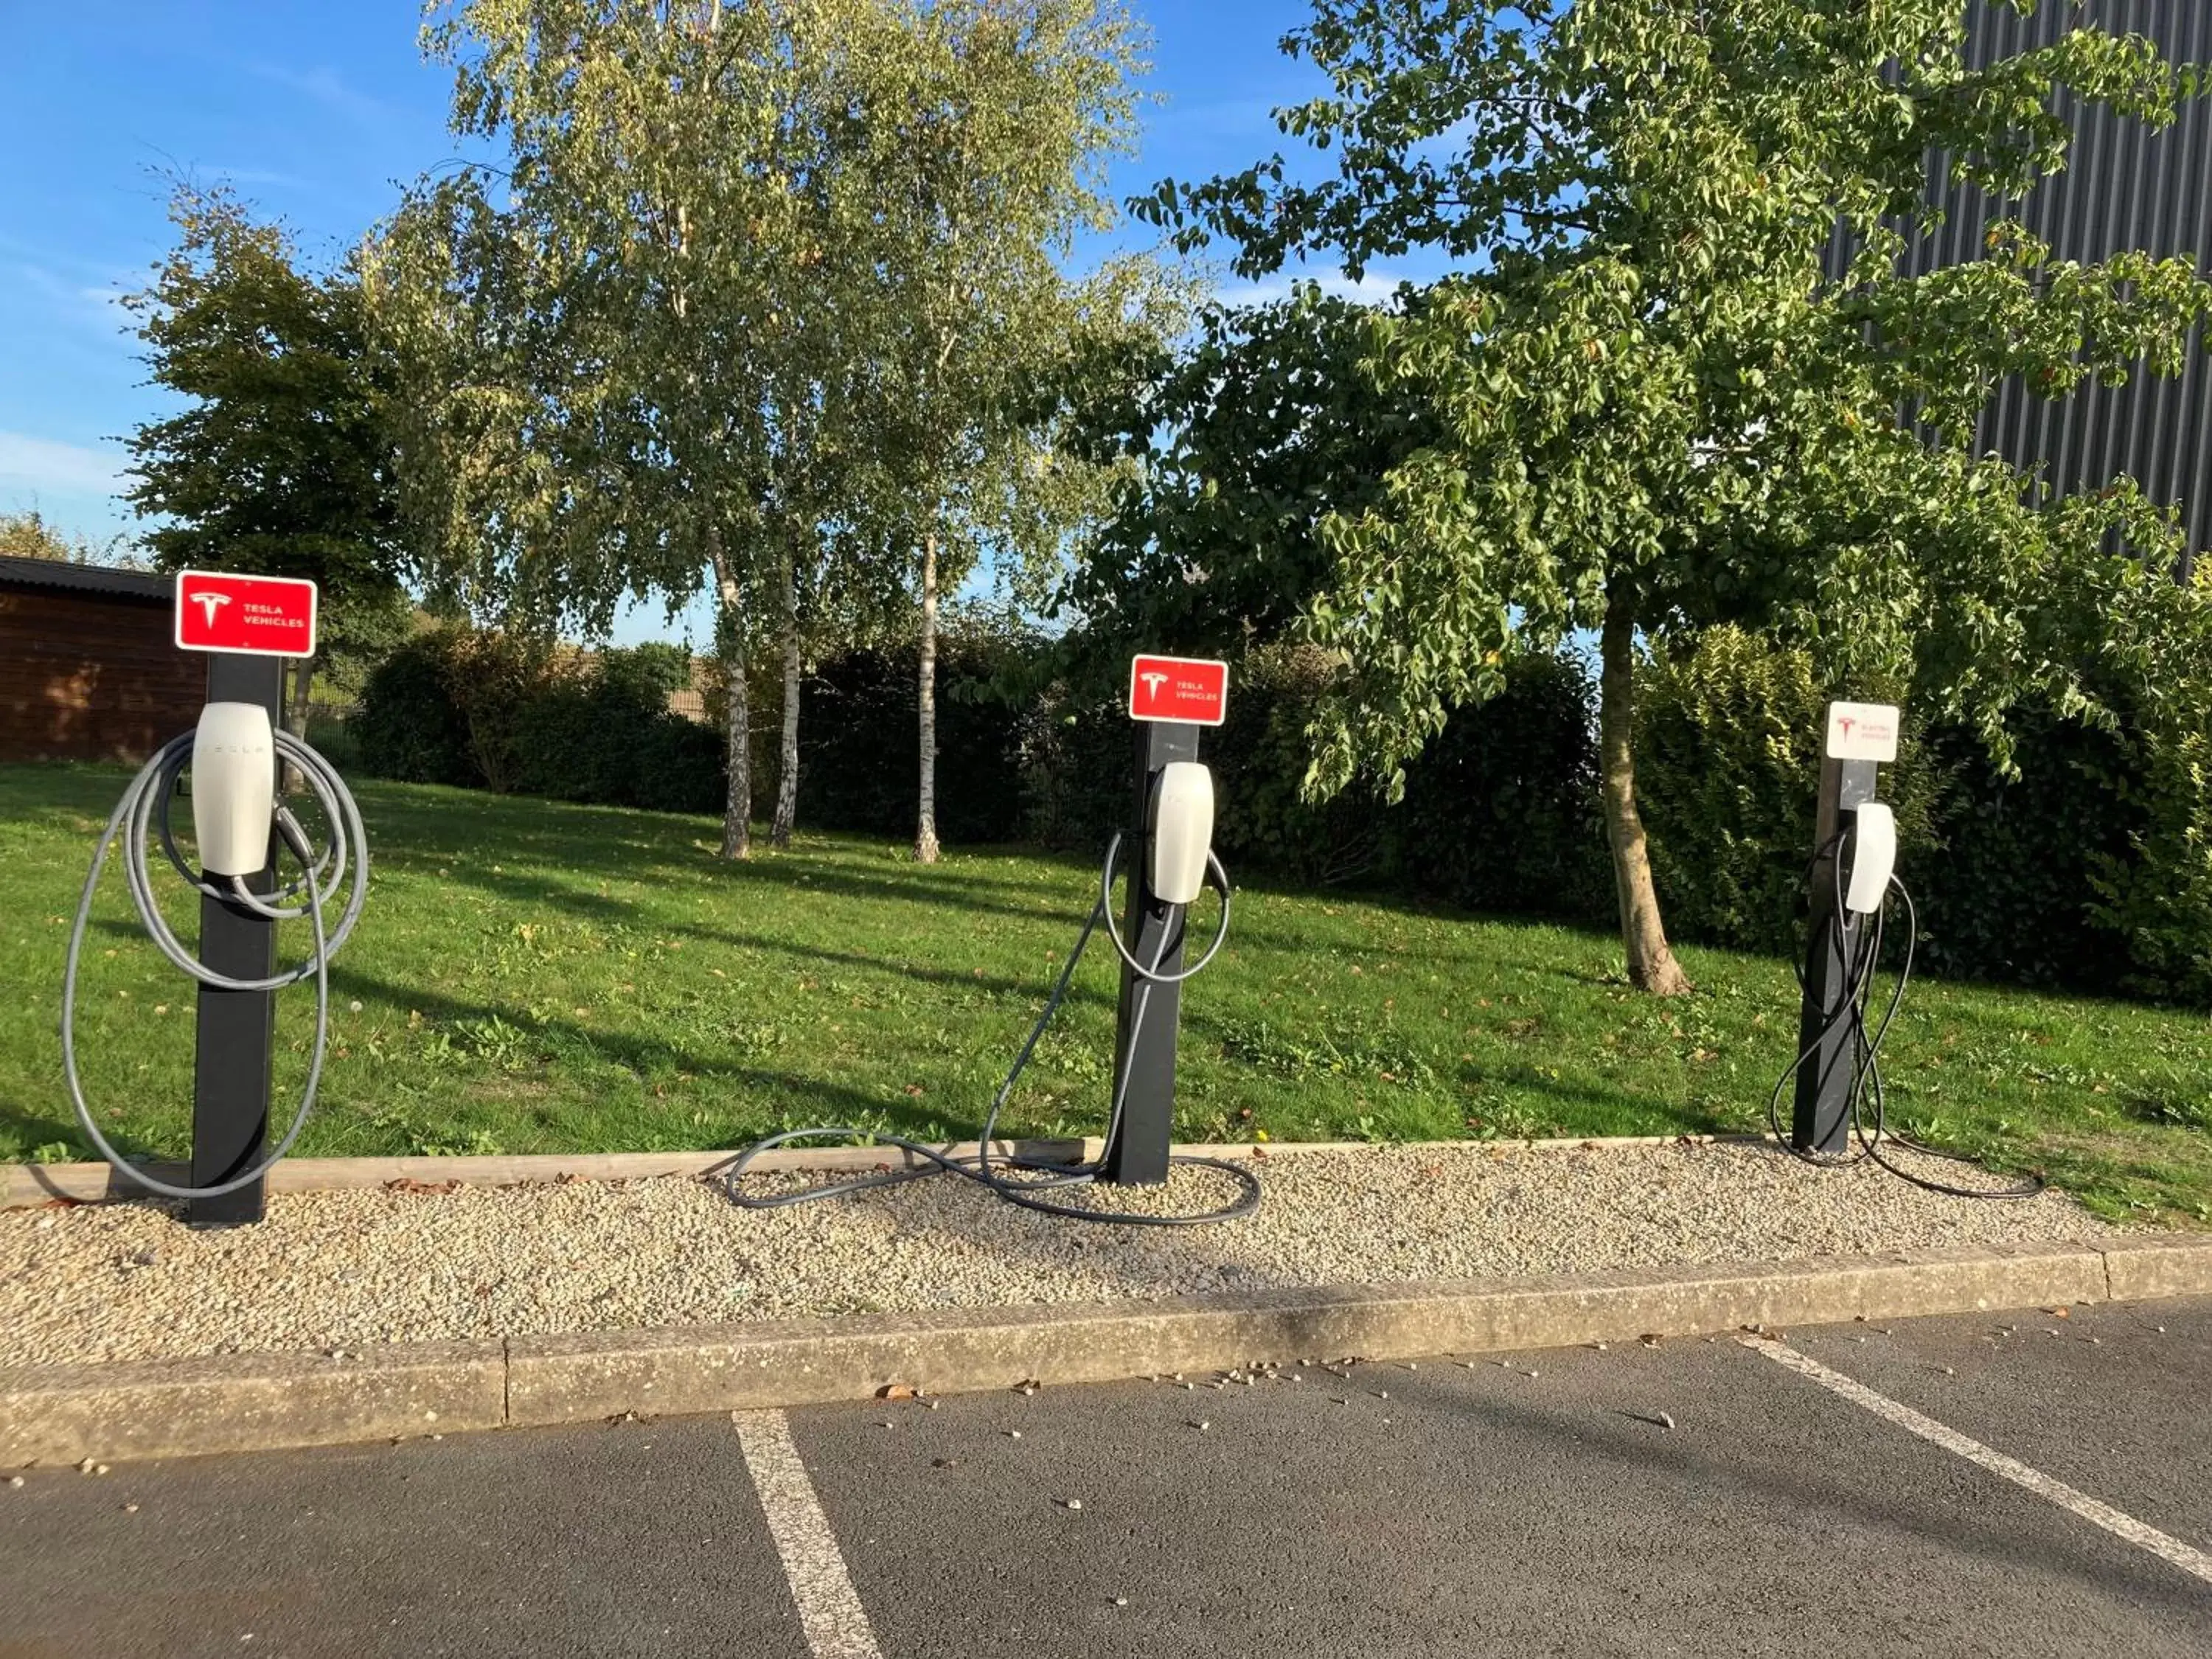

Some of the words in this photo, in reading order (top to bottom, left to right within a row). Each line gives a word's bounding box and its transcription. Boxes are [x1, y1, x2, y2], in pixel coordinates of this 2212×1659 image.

[243, 603, 283, 614] TESLA
[243, 615, 305, 628] VEHICLES
[1176, 681, 1203, 690] TESLA
